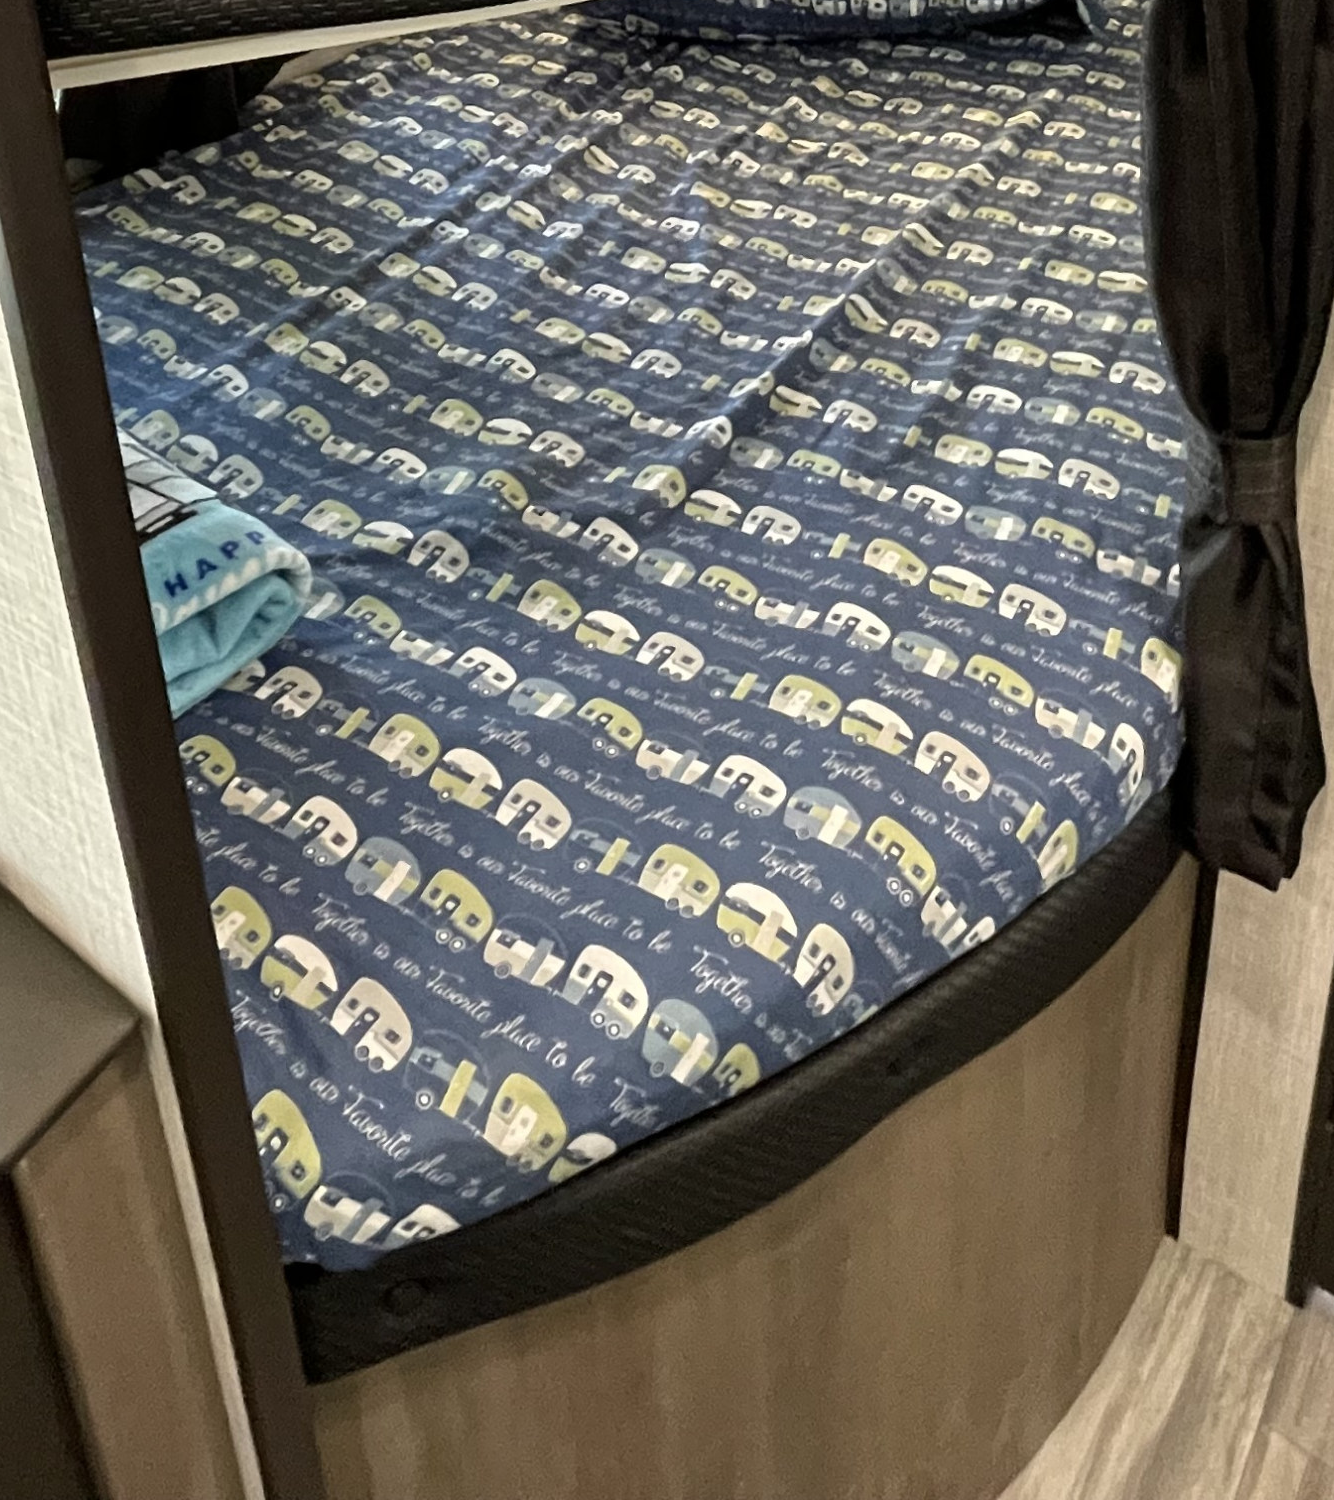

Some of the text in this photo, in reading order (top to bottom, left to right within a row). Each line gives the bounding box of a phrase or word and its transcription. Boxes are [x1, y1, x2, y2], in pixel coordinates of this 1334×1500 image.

[758, 842, 823, 893] Together
[690, 946, 753, 1013] Together
[479, 1014, 541, 1051] place
[572, 1056, 596, 1084] be
